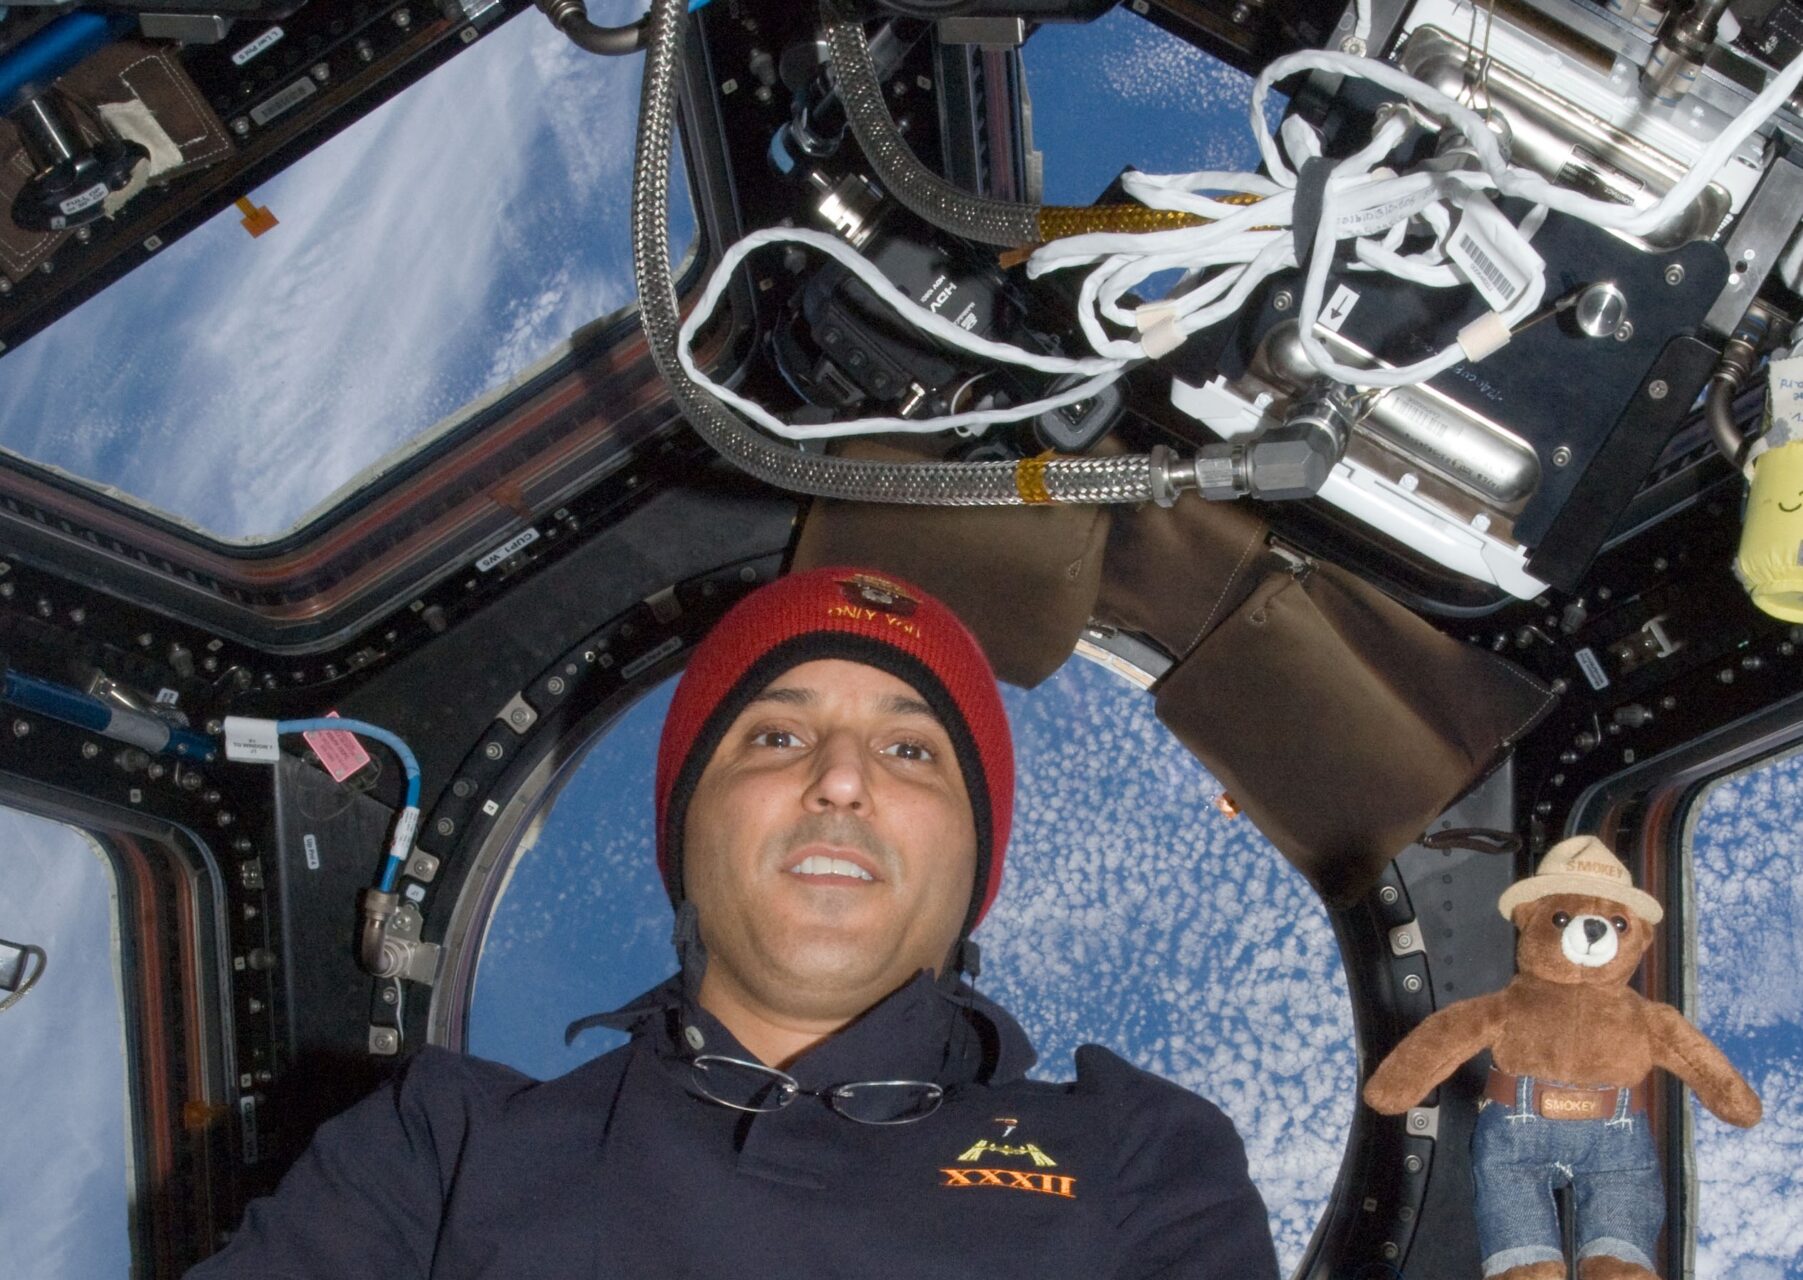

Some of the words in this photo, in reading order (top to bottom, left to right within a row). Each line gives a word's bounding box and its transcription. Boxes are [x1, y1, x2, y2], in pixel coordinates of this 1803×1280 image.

[930, 281, 958, 313] HDV
[1566, 859, 1622, 878] SMOKEY
[1543, 1097, 1595, 1111] SMOKEY
[939, 1168, 1076, 1198] XXXII
